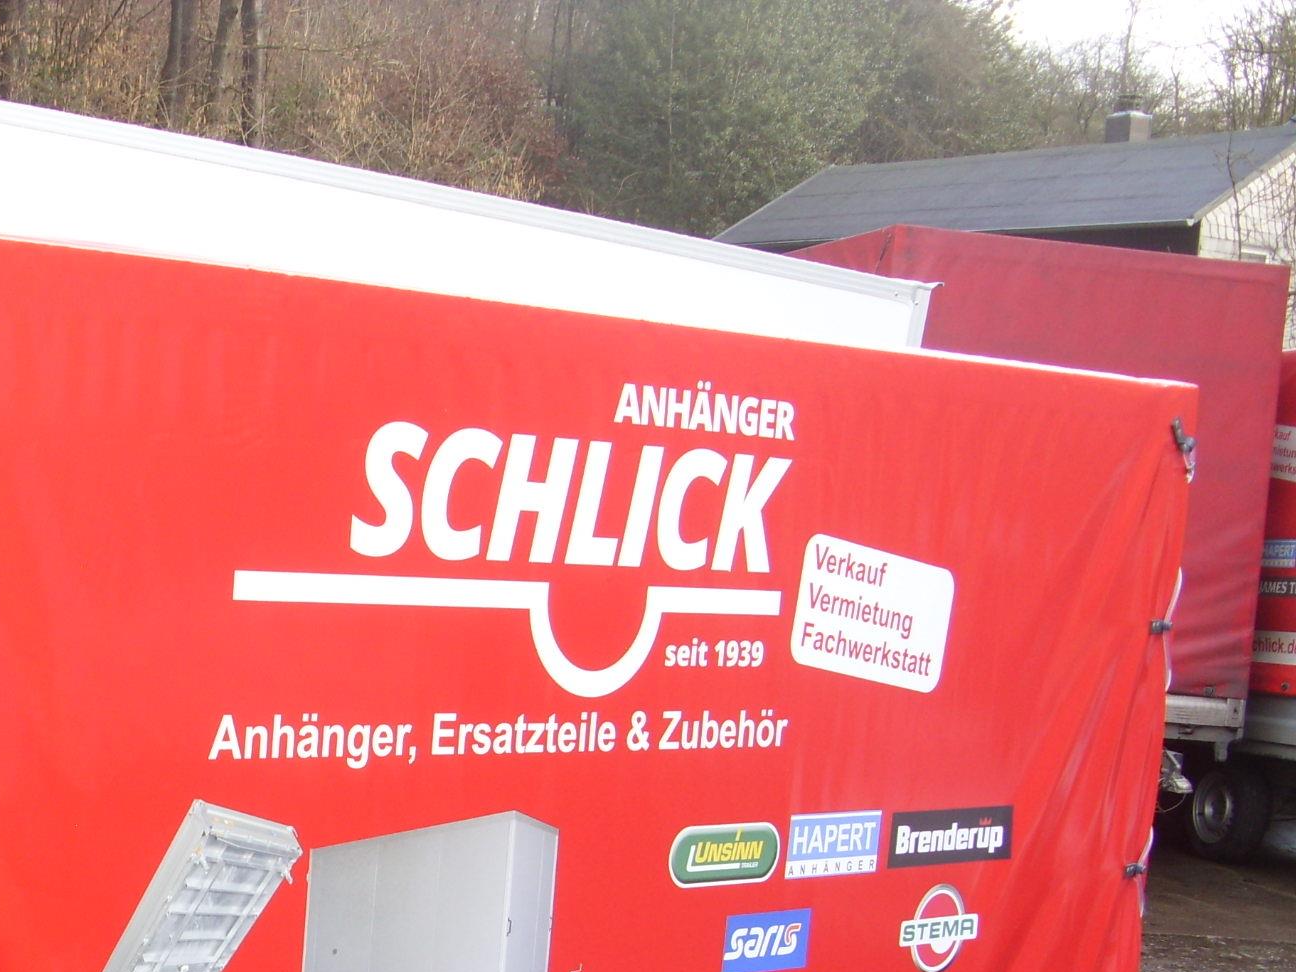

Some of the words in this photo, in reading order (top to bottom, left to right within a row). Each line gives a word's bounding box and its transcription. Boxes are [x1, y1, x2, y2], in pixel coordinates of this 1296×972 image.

[614, 381, 795, 441] ANHÄNGER
[349, 420, 792, 573] SCHLICK
[816, 543, 887, 587] Verkauf
[809, 582, 913, 640] Vermietung
[664, 639, 708, 668] seit
[714, 639, 764, 668] 1939
[801, 622, 931, 677] Fachwerkstatt
[208, 713, 417, 770] Anhänger,
[430, 711, 616, 756] Ersatzteile
[626, 710, 650, 751] &
[659, 708, 789, 751] Zubehör
[792, 820, 877, 856] HAPERT
[895, 822, 1004, 854] Brenderup
[787, 857, 876, 878] ANHÄNGER
[902, 918, 975, 943] STEMA
